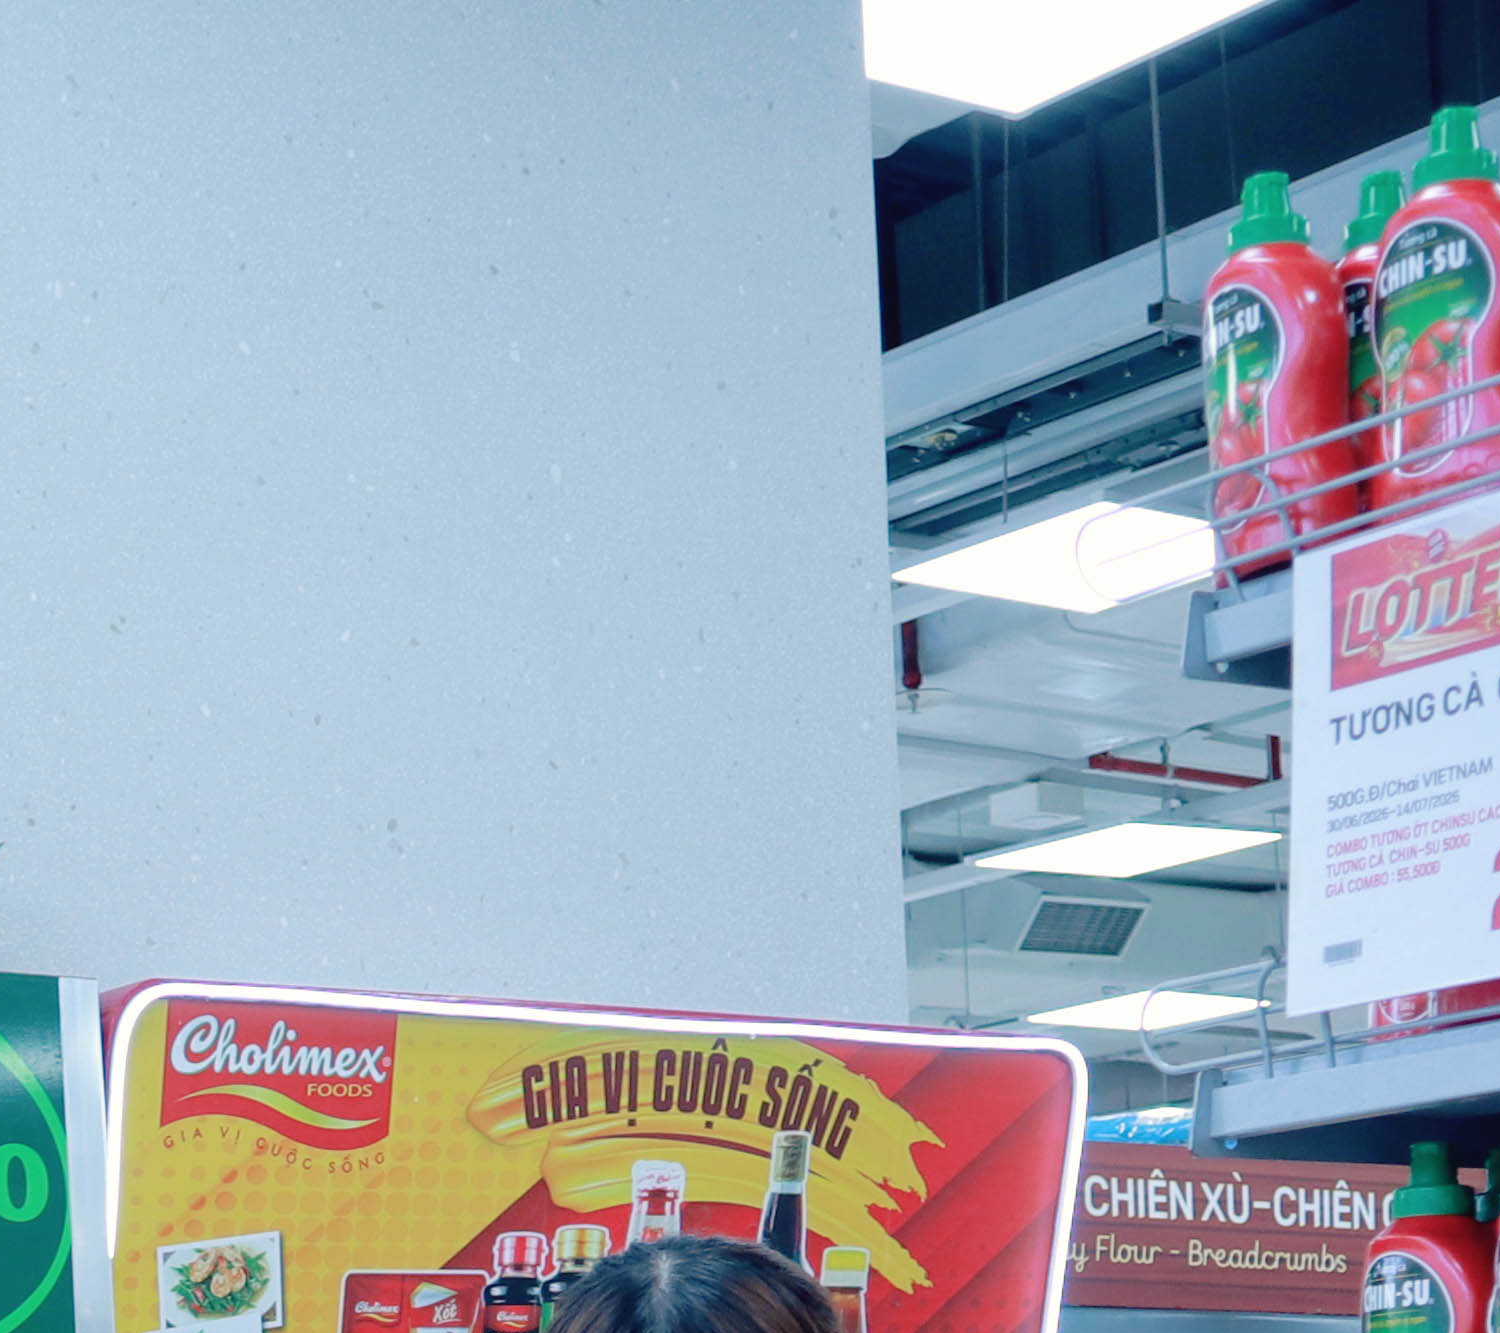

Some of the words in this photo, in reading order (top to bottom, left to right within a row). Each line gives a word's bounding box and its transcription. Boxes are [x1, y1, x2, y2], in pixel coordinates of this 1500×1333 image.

[1330, 693, 1435, 746] TƯƠNG
[1444, 670, 1484, 718] CÀ
[1422, 757, 1493, 788] VIETNAM
[171, 1014, 388, 1084] Cholimex
[307, 1083, 373, 1097] FOODS
[521, 1060, 588, 1132] GIA
[601, 1055, 641, 1129] VỊ
[652, 1037, 753, 1137] CUỘC
[757, 1056, 859, 1160] SỐNG
[163, 1127, 203, 1148] GIA
[220, 1126, 241, 1145] VỊ
[255, 1137, 313, 1170] CUỘC
[328, 1151, 385, 1174] SỐNG
[1084, 1168, 1193, 1220] CHIÊN
[1096, 1233, 1162, 1264] Flour
[1188, 1240, 1348, 1273] Breadcrumbs
[433, 1298, 458, 1323] Xốt
